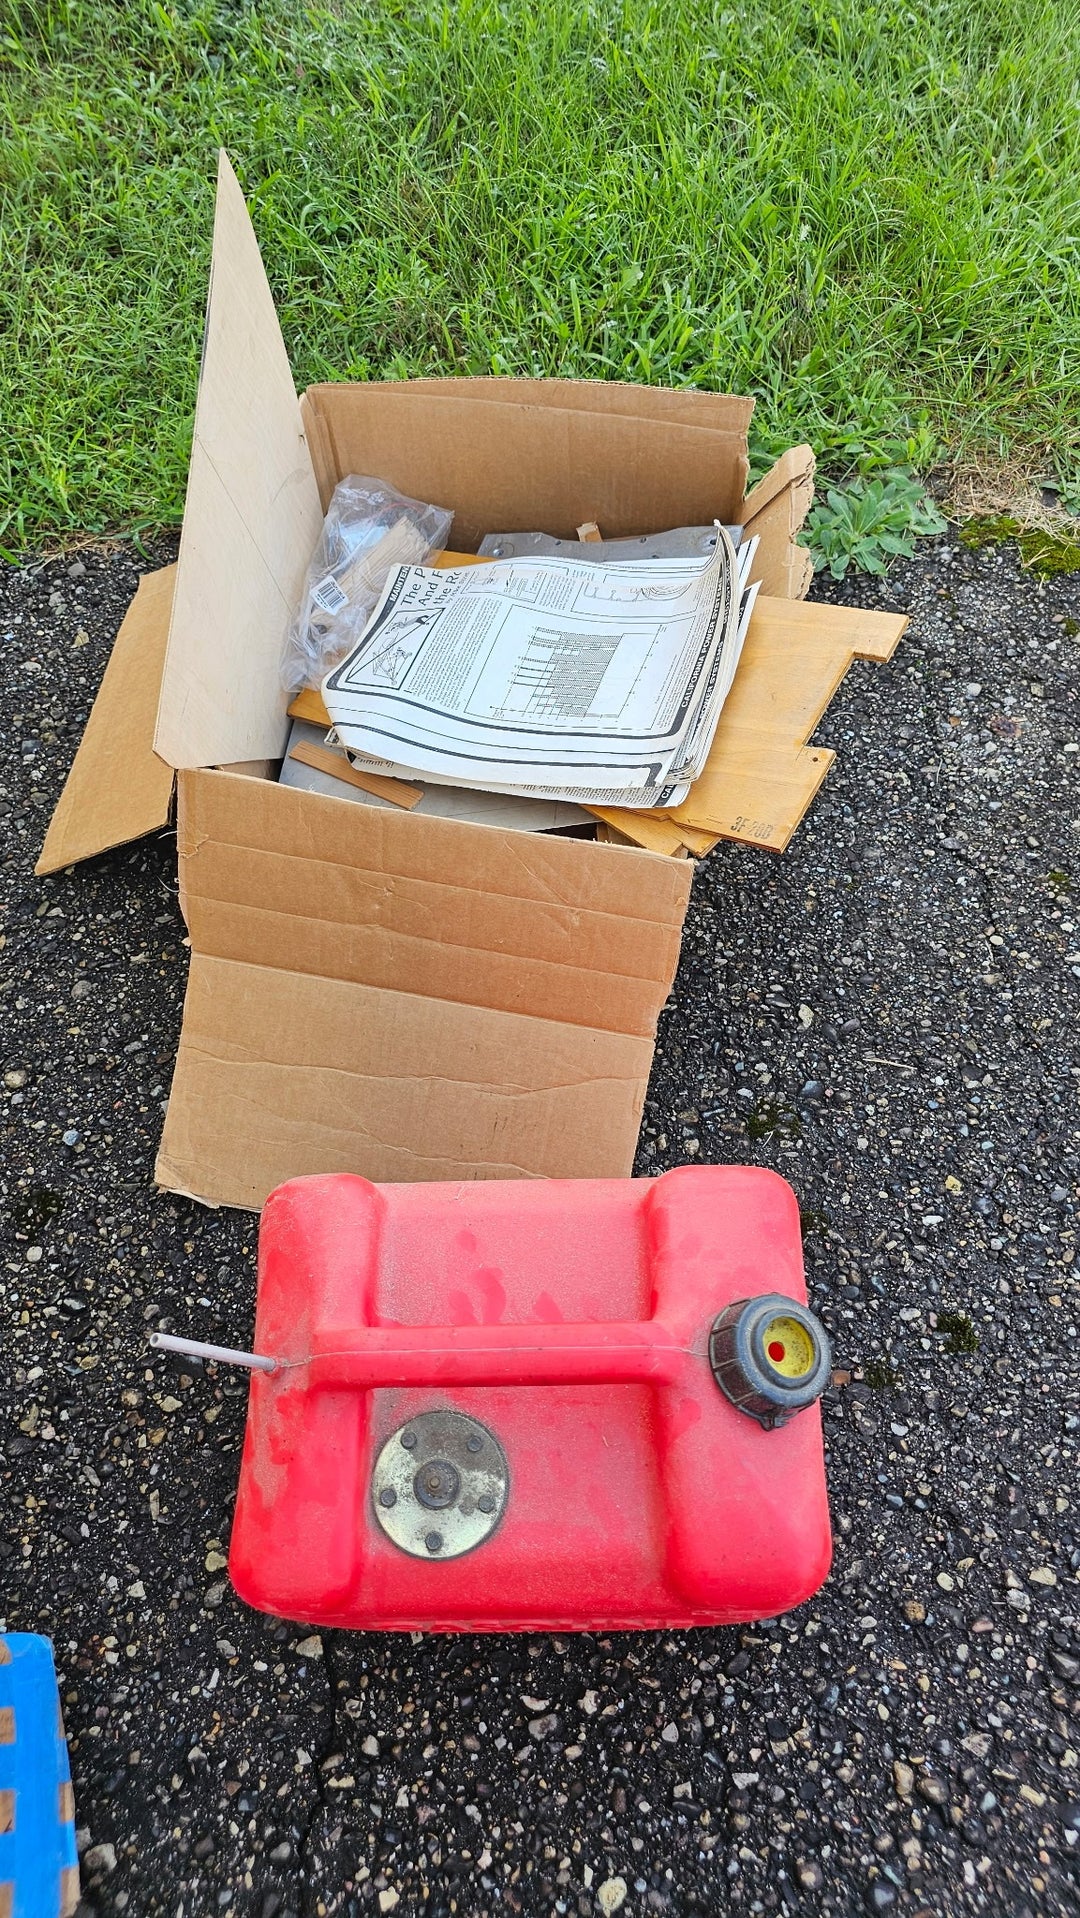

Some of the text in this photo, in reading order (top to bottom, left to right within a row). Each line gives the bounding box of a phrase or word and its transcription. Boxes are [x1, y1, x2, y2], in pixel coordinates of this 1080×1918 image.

[400, 583, 422, 606] The
[418, 581, 439, 606] And
[433, 587, 452, 604] the
[681, 654, 706, 708] CALIFORNIA
[701, 621, 716, 656] POWER
